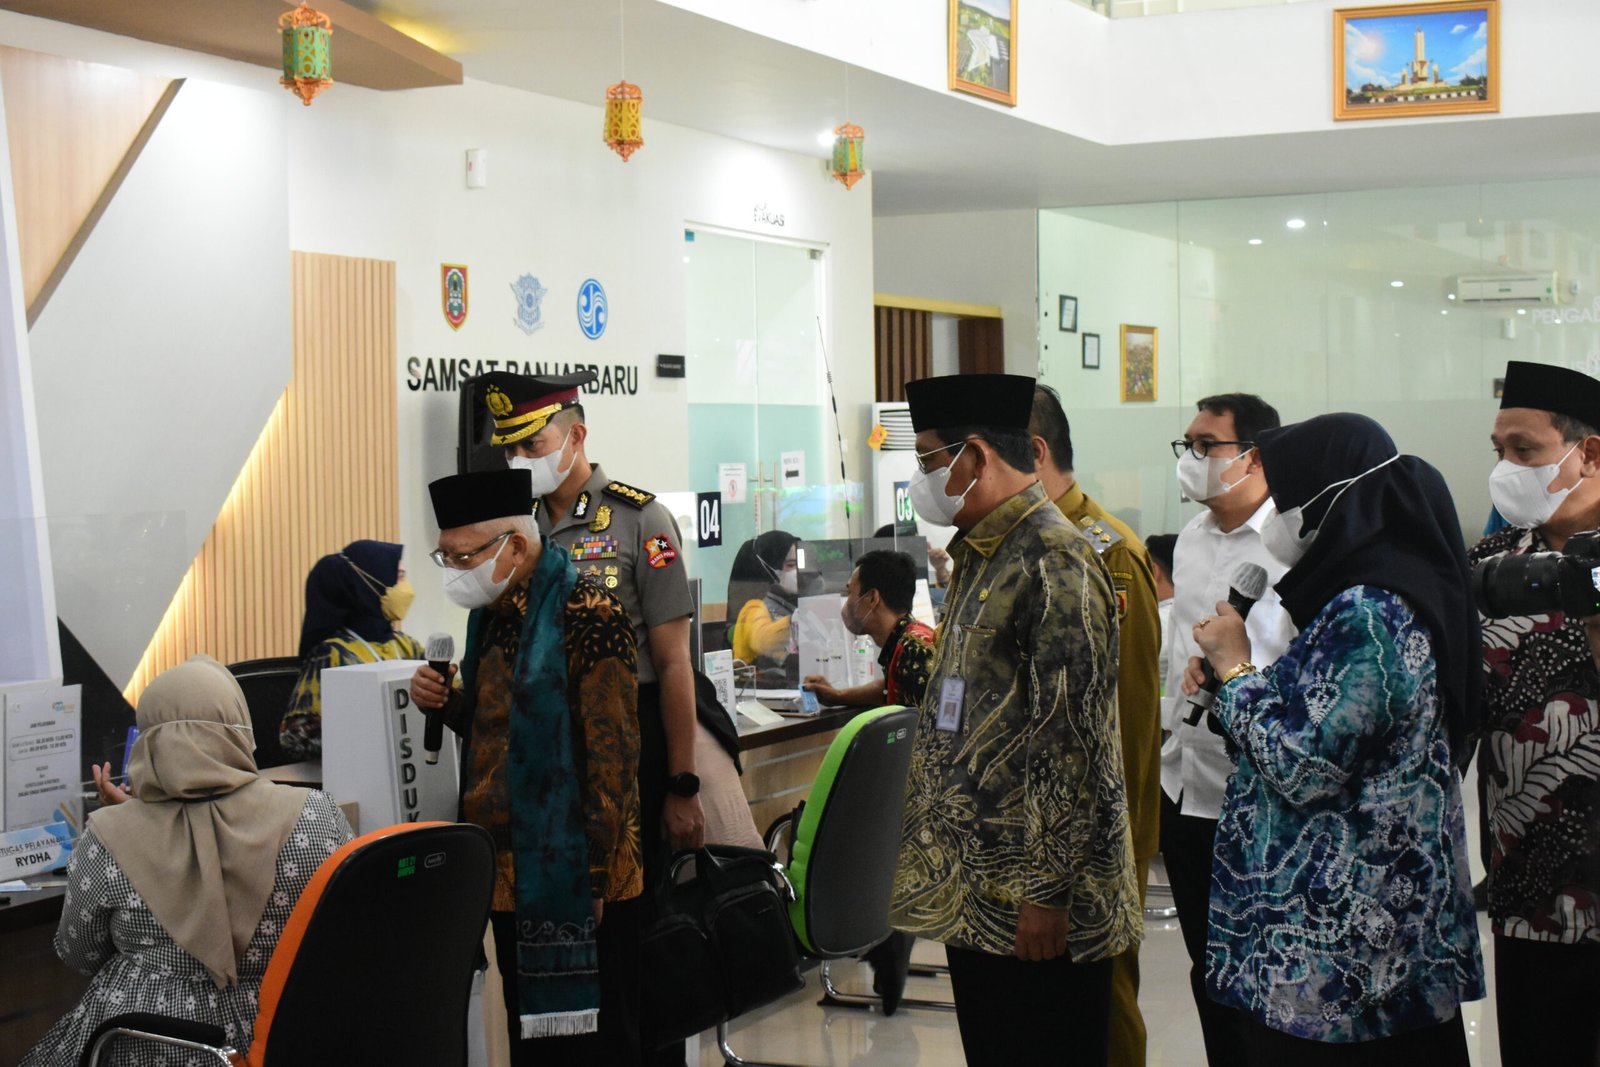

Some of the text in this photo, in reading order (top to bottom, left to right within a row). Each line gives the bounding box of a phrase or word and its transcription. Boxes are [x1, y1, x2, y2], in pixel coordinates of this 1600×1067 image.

[700, 499, 720, 540] 04
[896, 487, 913, 521] 03
[15, 851, 52, 867] RYDHA
